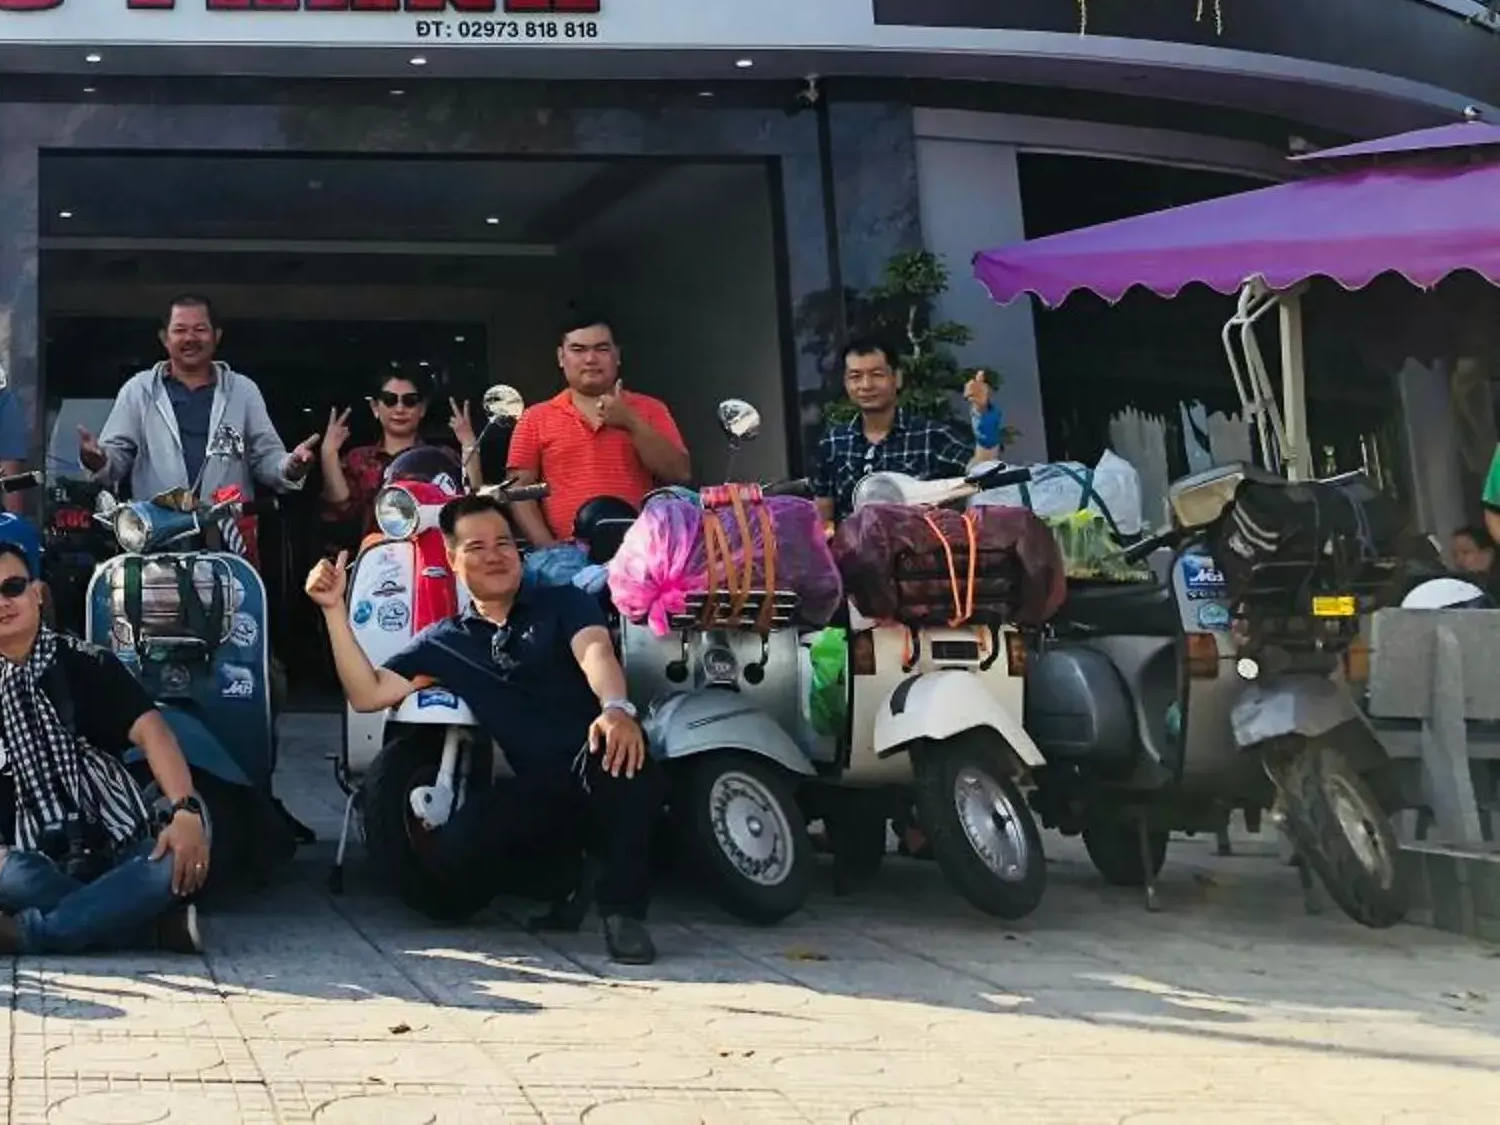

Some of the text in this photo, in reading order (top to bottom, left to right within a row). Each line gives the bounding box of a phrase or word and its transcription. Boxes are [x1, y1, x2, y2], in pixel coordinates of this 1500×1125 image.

[415, 20, 599, 38] ĐT: 02973 818 818
